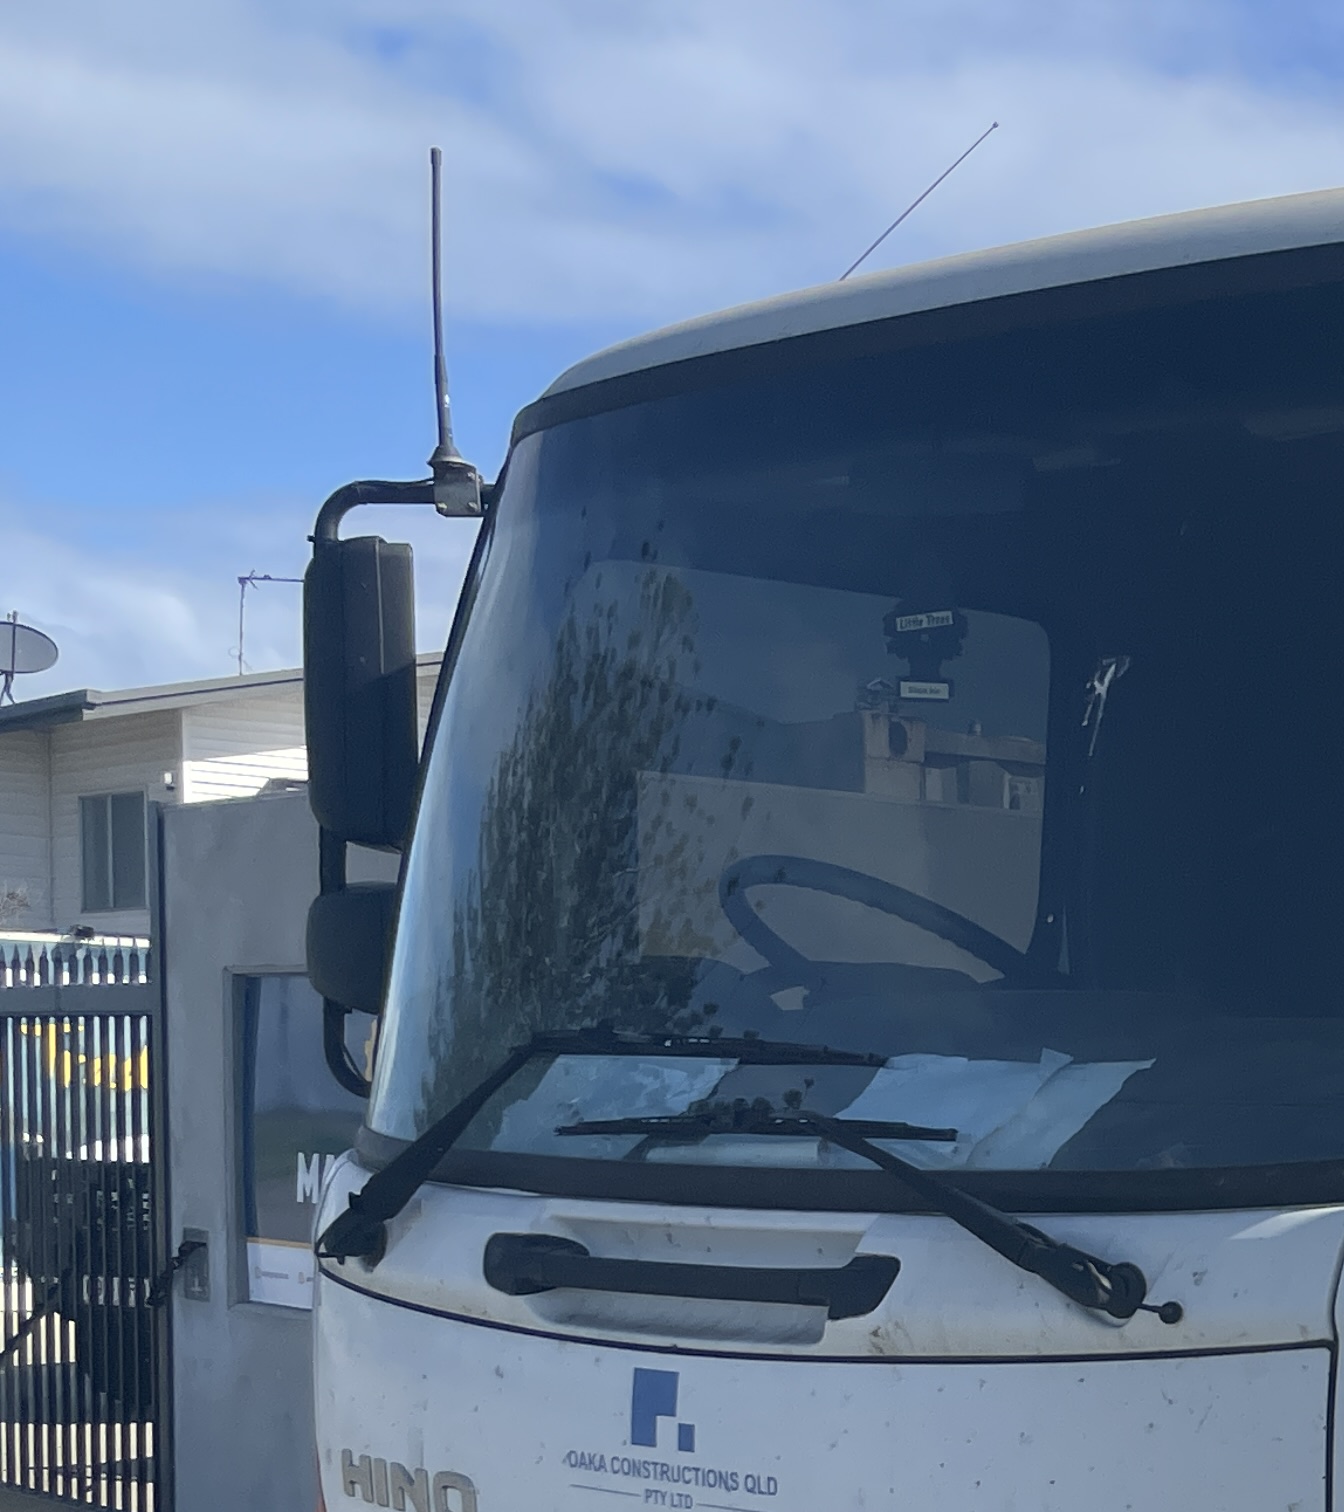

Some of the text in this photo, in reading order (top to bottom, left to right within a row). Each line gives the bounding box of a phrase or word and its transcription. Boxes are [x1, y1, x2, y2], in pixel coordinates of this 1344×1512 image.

[569, 1450, 778, 1496] OAKA CONSTRUCTIONS QLD
[644, 1488, 694, 1509] PTY LTD
